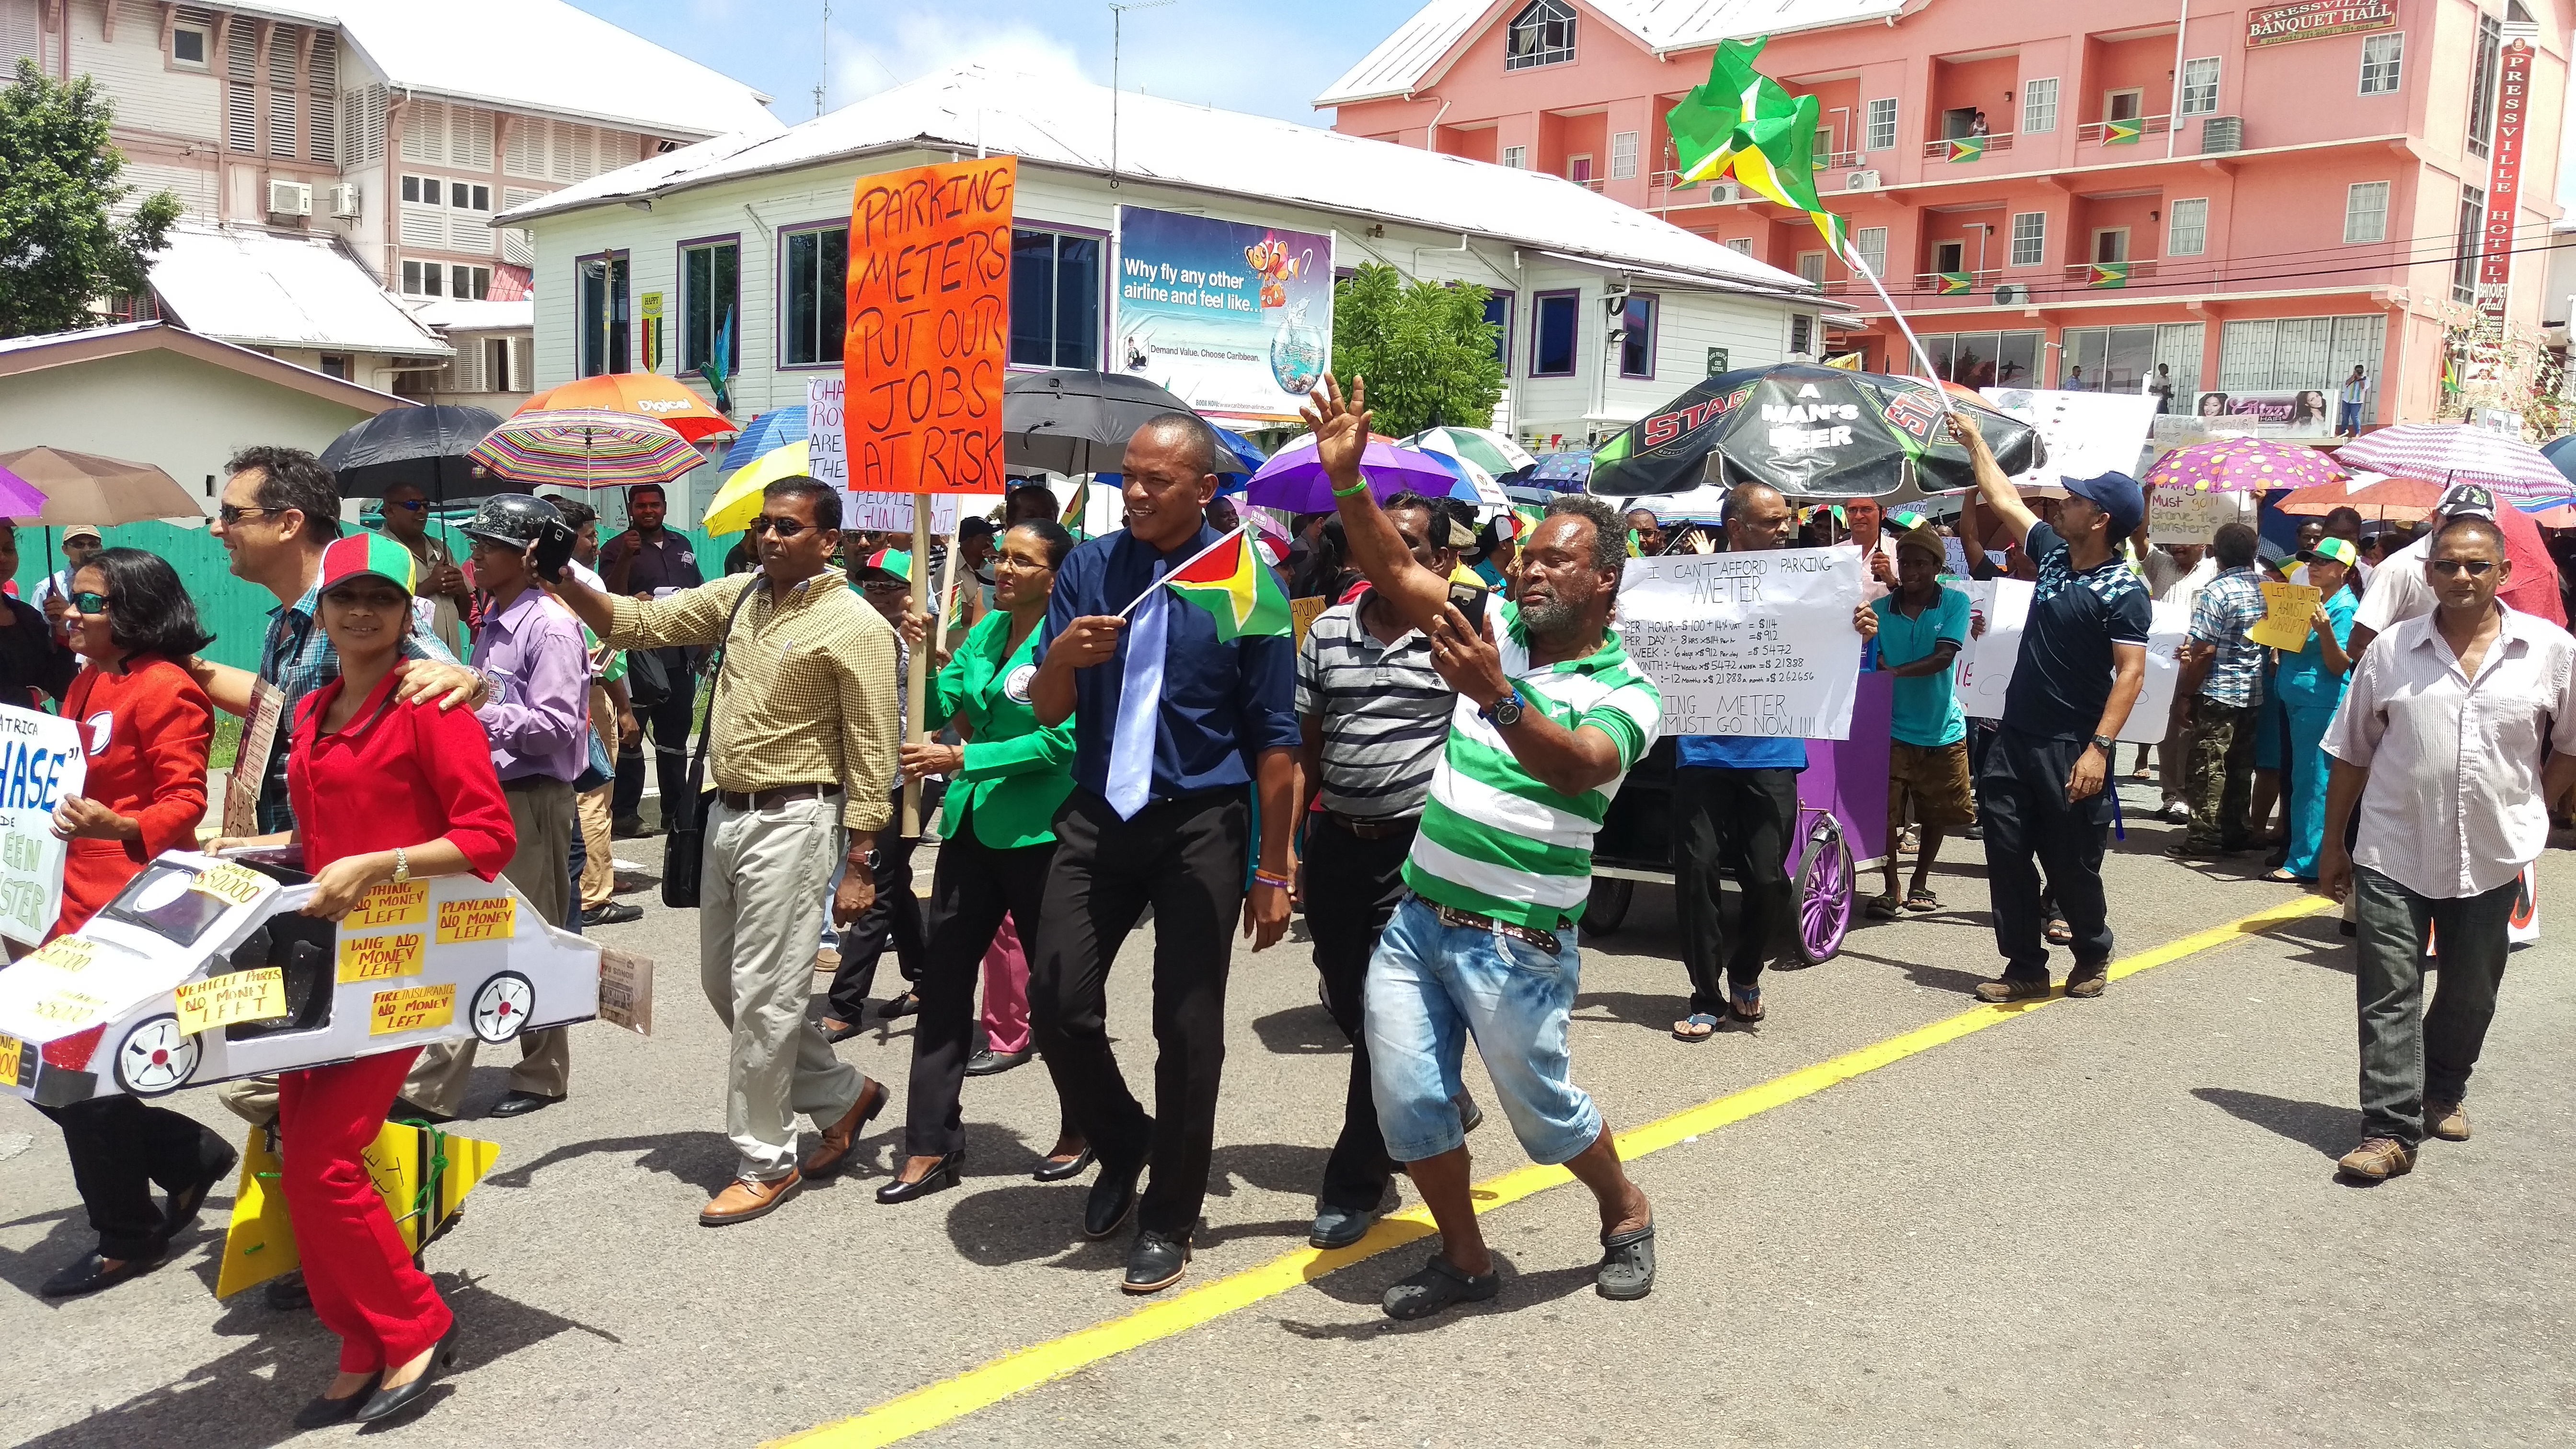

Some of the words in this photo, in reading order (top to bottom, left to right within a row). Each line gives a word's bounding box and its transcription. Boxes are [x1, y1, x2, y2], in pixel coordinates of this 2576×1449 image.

[2250, 12, 2337, 36] BANQUET
[2342, 4, 2392, 22] HALL
[2495, 57, 2524, 193] PRESSVILLE
[857, 167, 1012, 247] PARKING
[2487, 210, 2510, 276] HOTEL
[856, 225, 1010, 304] METERS
[1125, 258, 1157, 282] Why
[1161, 263, 1177, 285] fly
[1181, 269, 1206, 288] any
[1208, 271, 1244, 289] other
[1124, 282, 1168, 302] airline
[1171, 290, 1196, 306] and
[1200, 292, 1224, 309] feel
[1227, 293, 1263, 313] like...
[2478, 283, 2507, 298] BANQUET
[644, 297, 659, 305] HAPPY
[2478, 298, 2504, 312] Hall
[852, 306, 931, 379] PUT
[938, 294, 1004, 359] OUR
[1150, 345, 1179, 355] Demand
[1180, 347, 1199, 357] Value.
[1201, 349, 1225, 359] Choose
[1227, 351, 1260, 362] Caribbean.
[868, 358, 993, 433] JOBS
[1797, 383, 1821, 398] A
[637, 398, 692, 413] Digicel
[1761, 403, 1859, 424] MAN'S
[1644, 389, 1748, 447] STAG
[2156, 415, 2182, 429] Fire
[2185, 417, 2204, 431] the
[809, 433, 842, 452] ARE
[865, 431, 912, 486] AT
[919, 426, 1003, 490] RISK
[809, 458, 846, 479] THE
[2152, 494, 2184, 507] Must
[856, 504, 895, 529] GUN
[902, 506, 953, 533] PNT
[2198, 511, 2218, 524] the
[2151, 521, 2211, 534] Monsters
[1647, 566, 1660, 579] I
[1674, 561, 1718, 579] CAN'T
[1720, 560, 1768, 576] AFFORD
[1780, 556, 1832, 574] PARKING
[1692, 575, 1763, 604] METER
[2271, 583, 2293, 599] LET'S
[2277, 601, 2305, 617] AGAINST
[1625, 621, 1640, 634] PER
[1729, 622, 1742, 631] VAT
[1759, 618, 1778, 629] $114
[2269, 614, 2312, 636] CORRUPTIO
[1625, 635, 1641, 646] PER
[1647, 635, 1667, 646] DAY
[1681, 635, 1687, 645] 8
[1632, 647, 1659, 658] WEEK
[1674, 645, 1680, 657] 6
[1681, 650, 1693, 660] days
[1729, 651, 1738, 659] day
[1716, 695, 1787, 717] METER
[1665, 716, 1712, 734] MUST
[1718, 716, 1742, 734] GO
[1753, 716, 1793, 735] NOW
[365, 882, 413, 896] THING
[0, 873, 45, 932] STER
[379, 890, 425, 908] MONEY
[442, 898, 509, 914] PLAYLAND
[364, 907, 410, 924] LEFT
[440, 914, 460, 928] NO
[466, 910, 513, 925] MONEY
[454, 924, 495, 939] LEFT
[351, 936, 385, 951] WIG
[395, 934, 419, 947] NO
[358, 946, 416, 966] MONEY
[359, 961, 405, 978] LEFT
[613, 967, 634, 980] BONUS
[176, 975, 238, 998] VEHICLE
[373, 991, 400, 1003] FIRE
[401, 983, 457, 1000] INSURANCE
[185, 997, 207, 1012] NO
[217, 983, 267, 1002] MONEY
[378, 1004, 396, 1016] NO
[405, 997, 449, 1012] MONEY
[203, 996, 268, 1023] LEFT
[387, 1013, 426, 1029] LEFT
